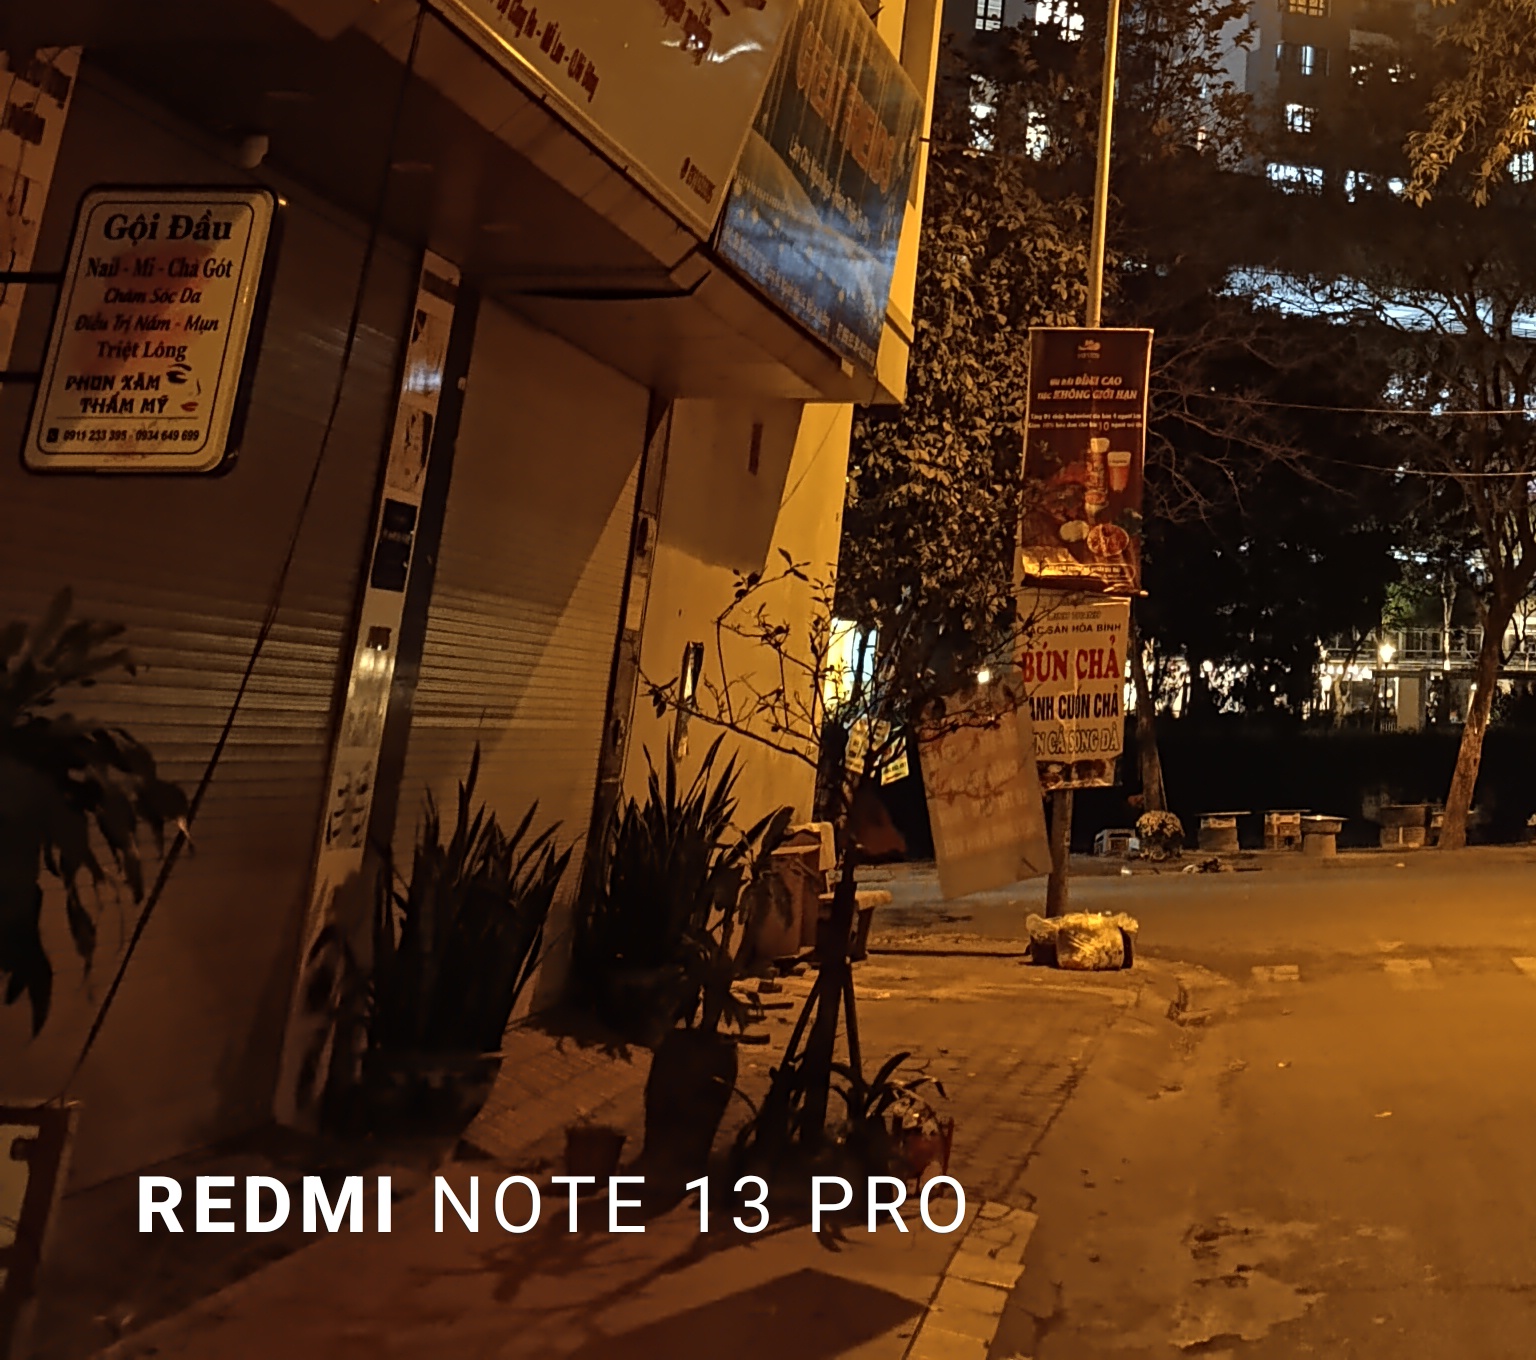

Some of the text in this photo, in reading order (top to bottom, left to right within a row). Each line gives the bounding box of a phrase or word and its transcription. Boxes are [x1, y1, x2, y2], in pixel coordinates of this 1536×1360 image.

[104, 208, 232, 247] Gội Đầu
[86, 257, 121, 278] Nail
[202, 257, 232, 279] Gót
[180, 288, 202, 304] Da
[184, 315, 219, 334] Mụn
[97, 340, 188, 362] Triệt Lông
[1022, 635, 1120, 682] BÚN CHẢ
[1093, 684, 1119, 719] CHẢ
